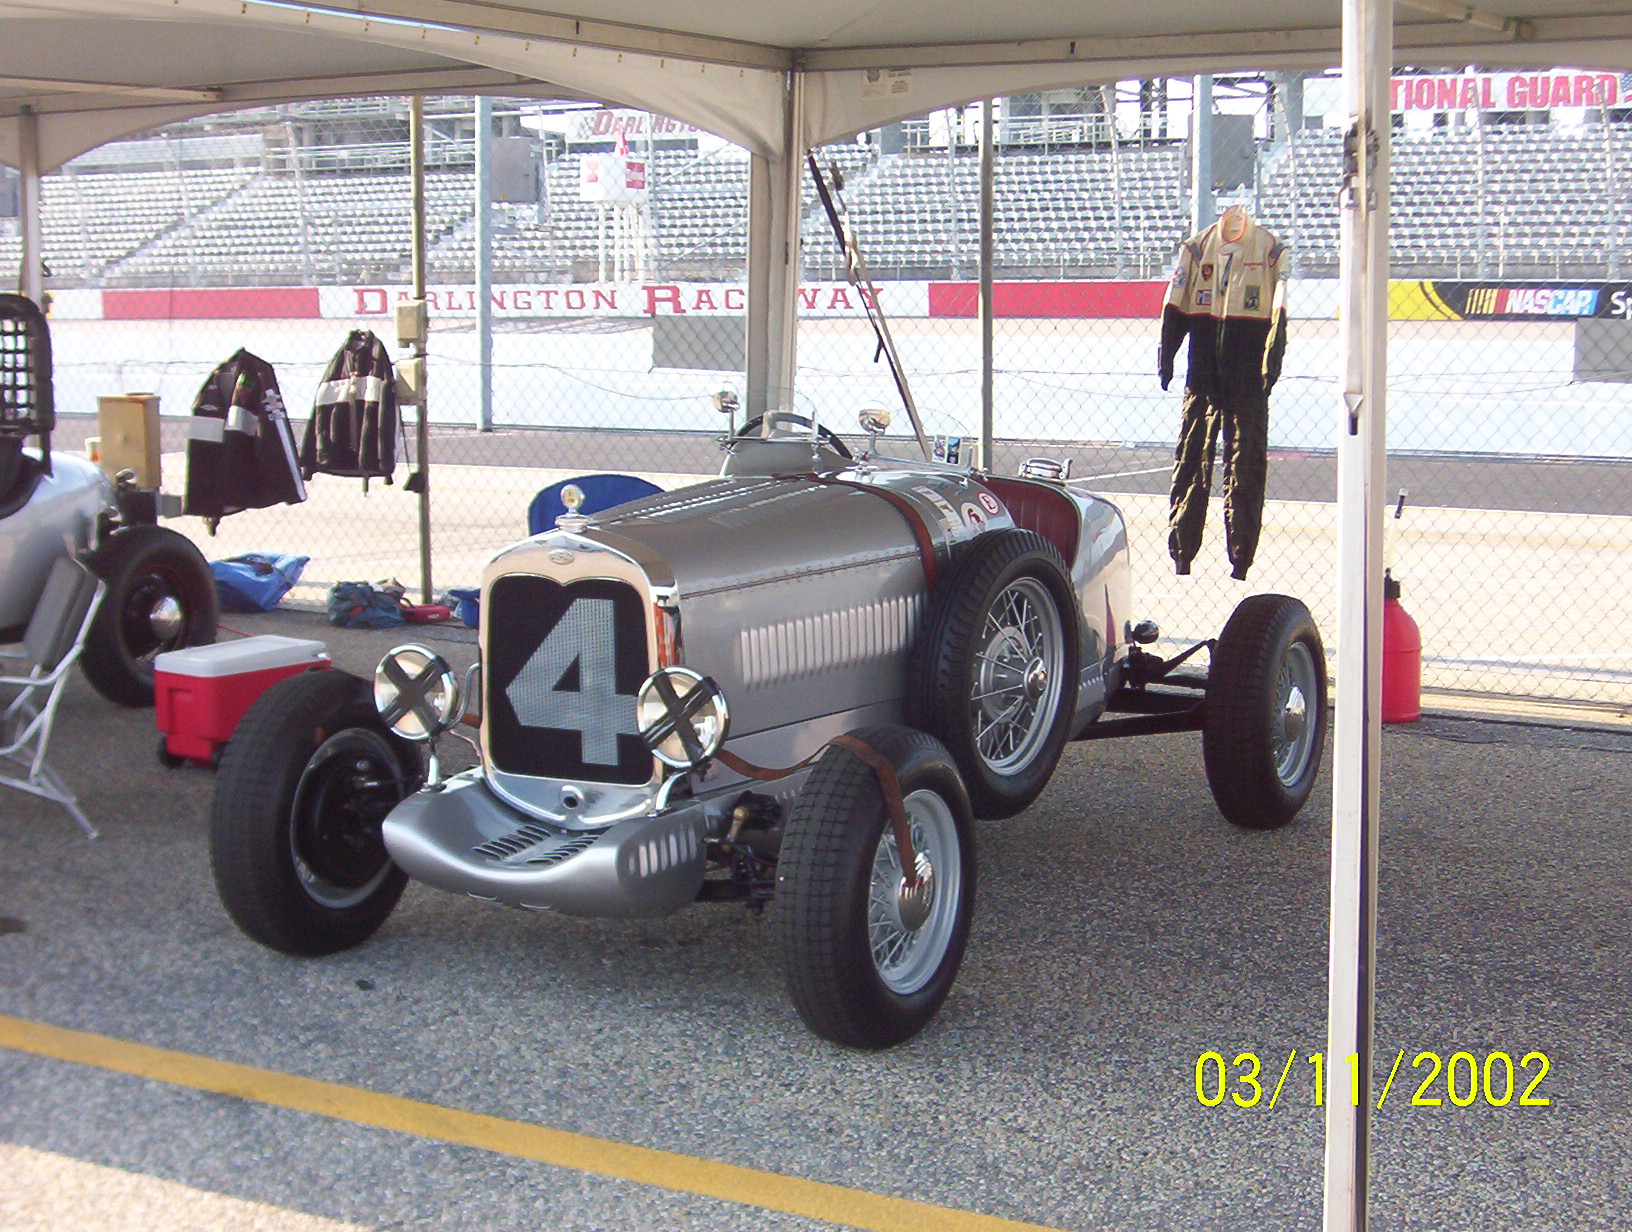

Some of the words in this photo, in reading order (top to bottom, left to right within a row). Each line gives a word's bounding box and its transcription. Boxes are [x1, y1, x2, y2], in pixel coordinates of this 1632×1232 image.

[1507, 74, 1618, 108] GUARD
[641, 286, 884, 314] RACWAY
[1505, 289, 1592, 314] NASCAR
[506, 598, 639, 766] 4
